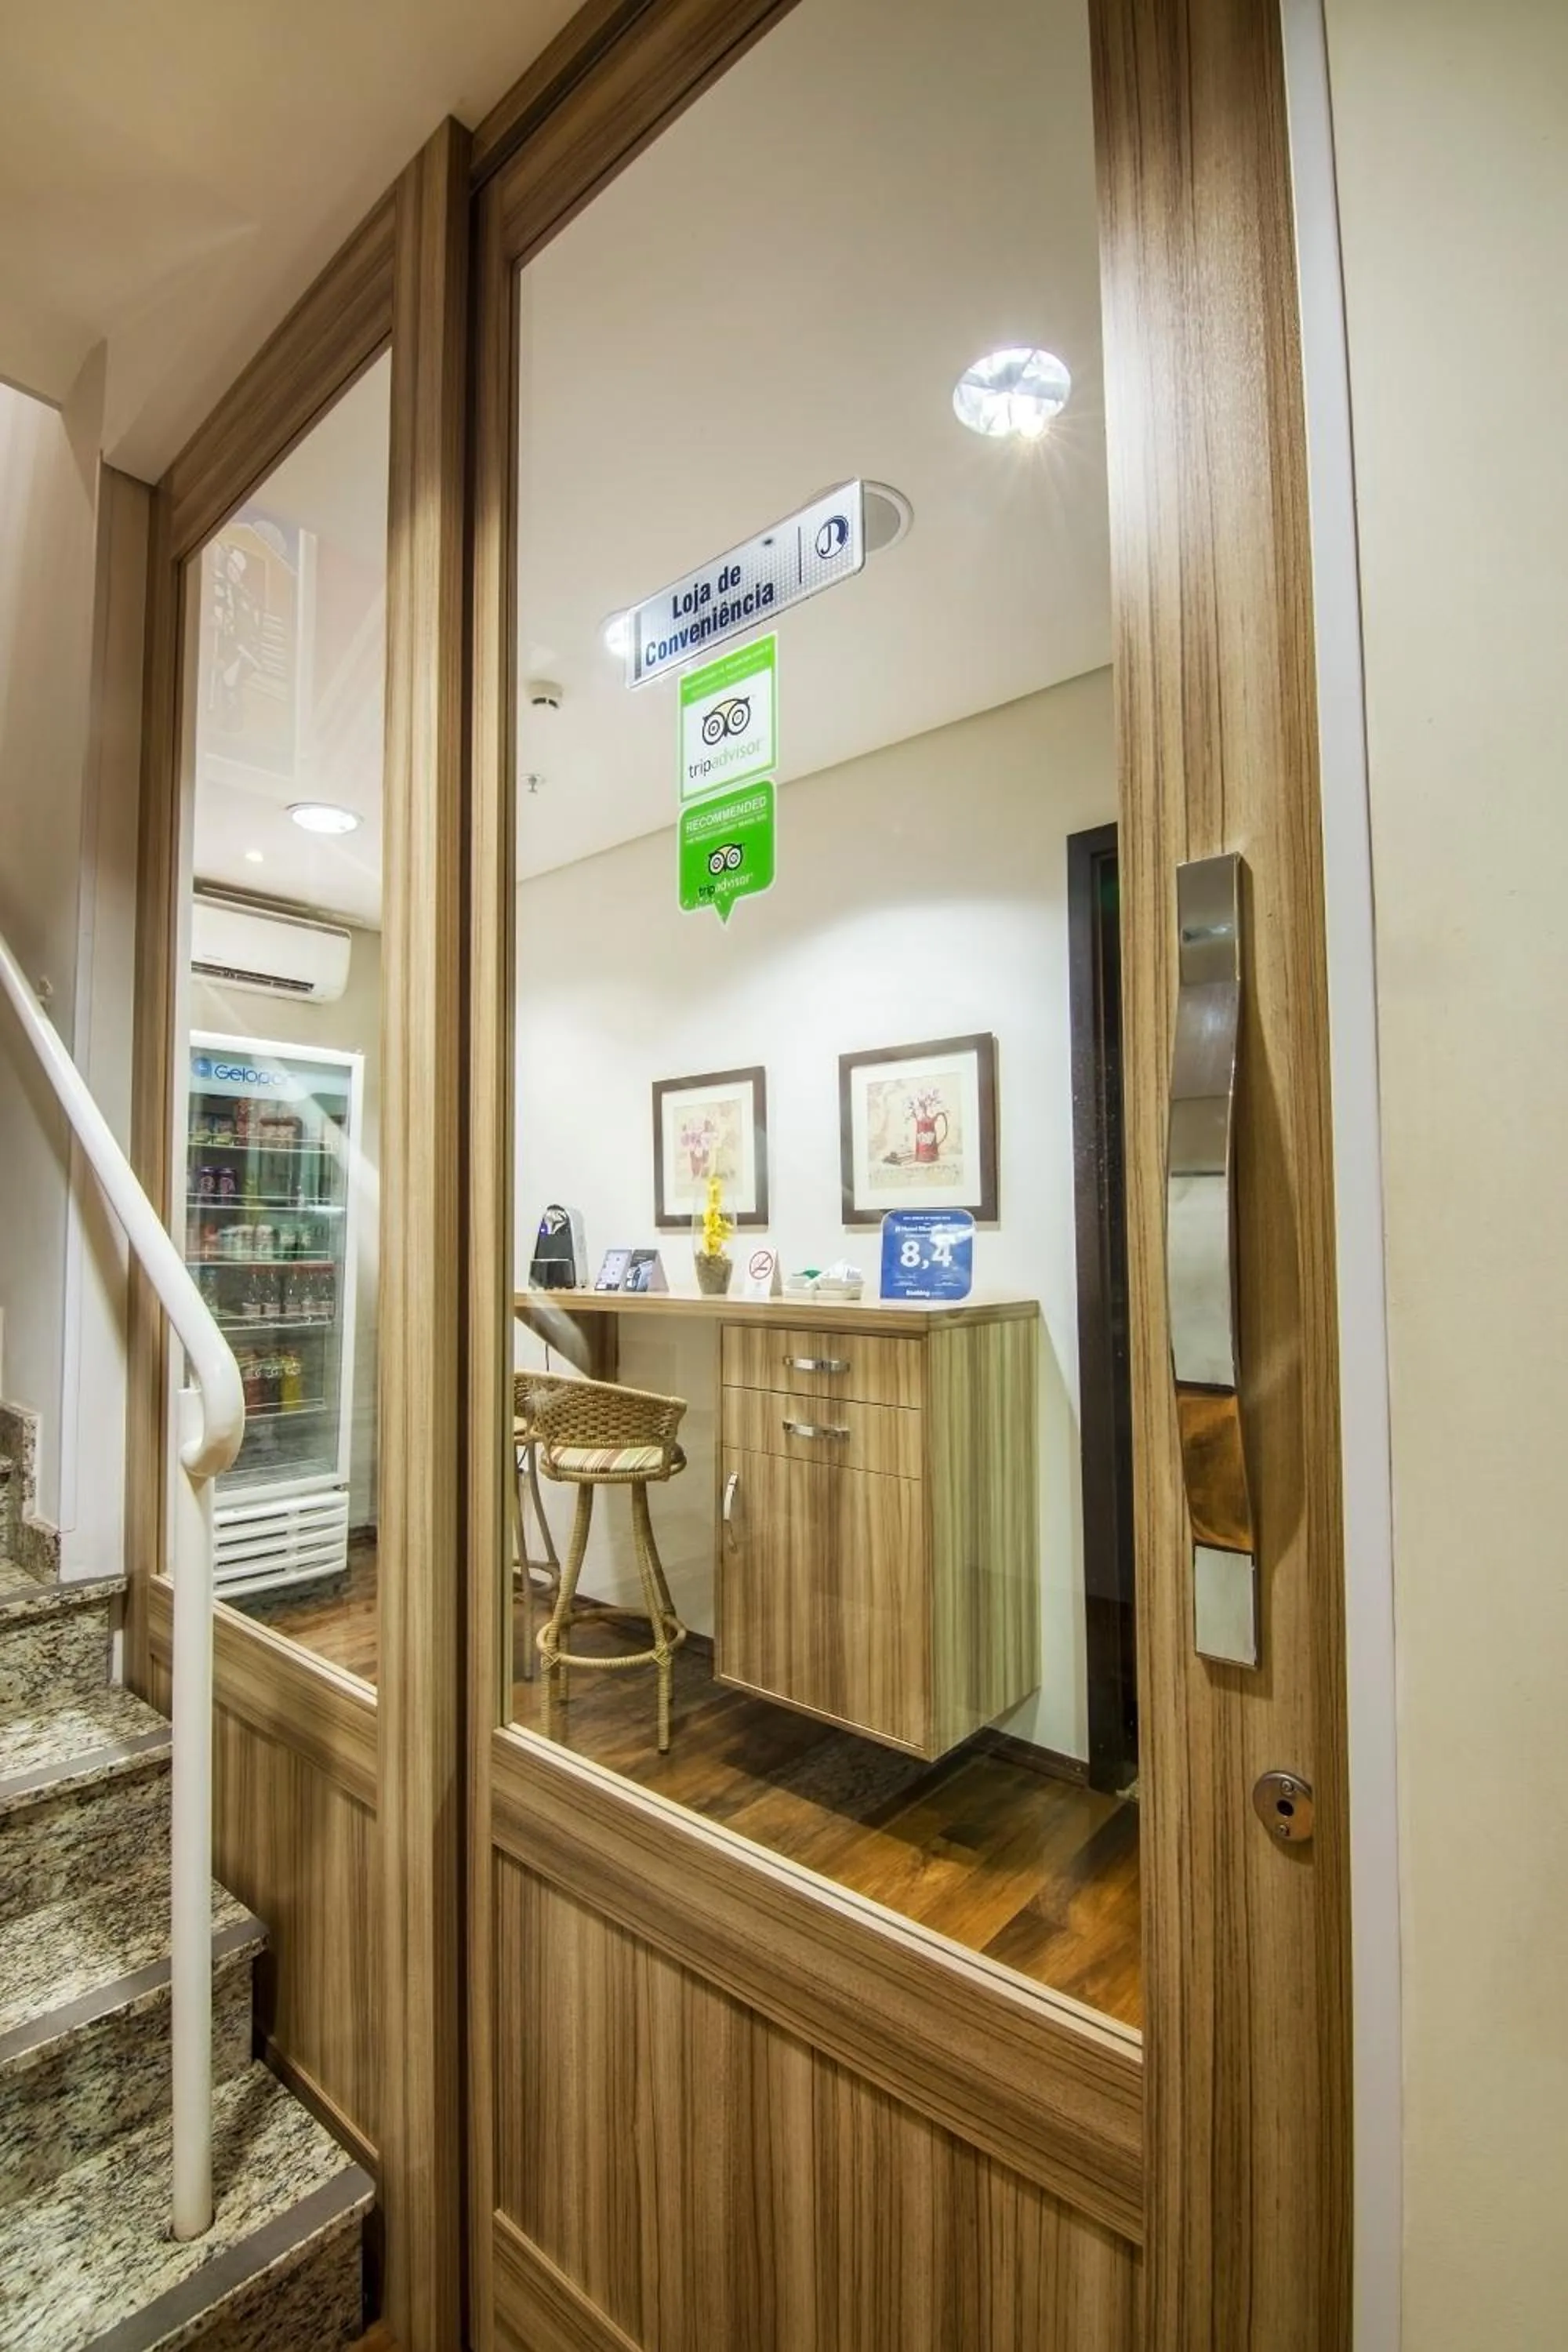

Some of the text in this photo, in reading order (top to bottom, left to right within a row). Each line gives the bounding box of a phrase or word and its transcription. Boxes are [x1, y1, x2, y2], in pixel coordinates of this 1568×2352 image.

[672, 564, 741, 619] Loja de
[645, 582, 775, 666] Conveniência
[688, 739, 761, 779] tripadvisor
[686, 796, 766, 833] RECOMMENDED
[900, 1240, 953, 1269] 8,4
